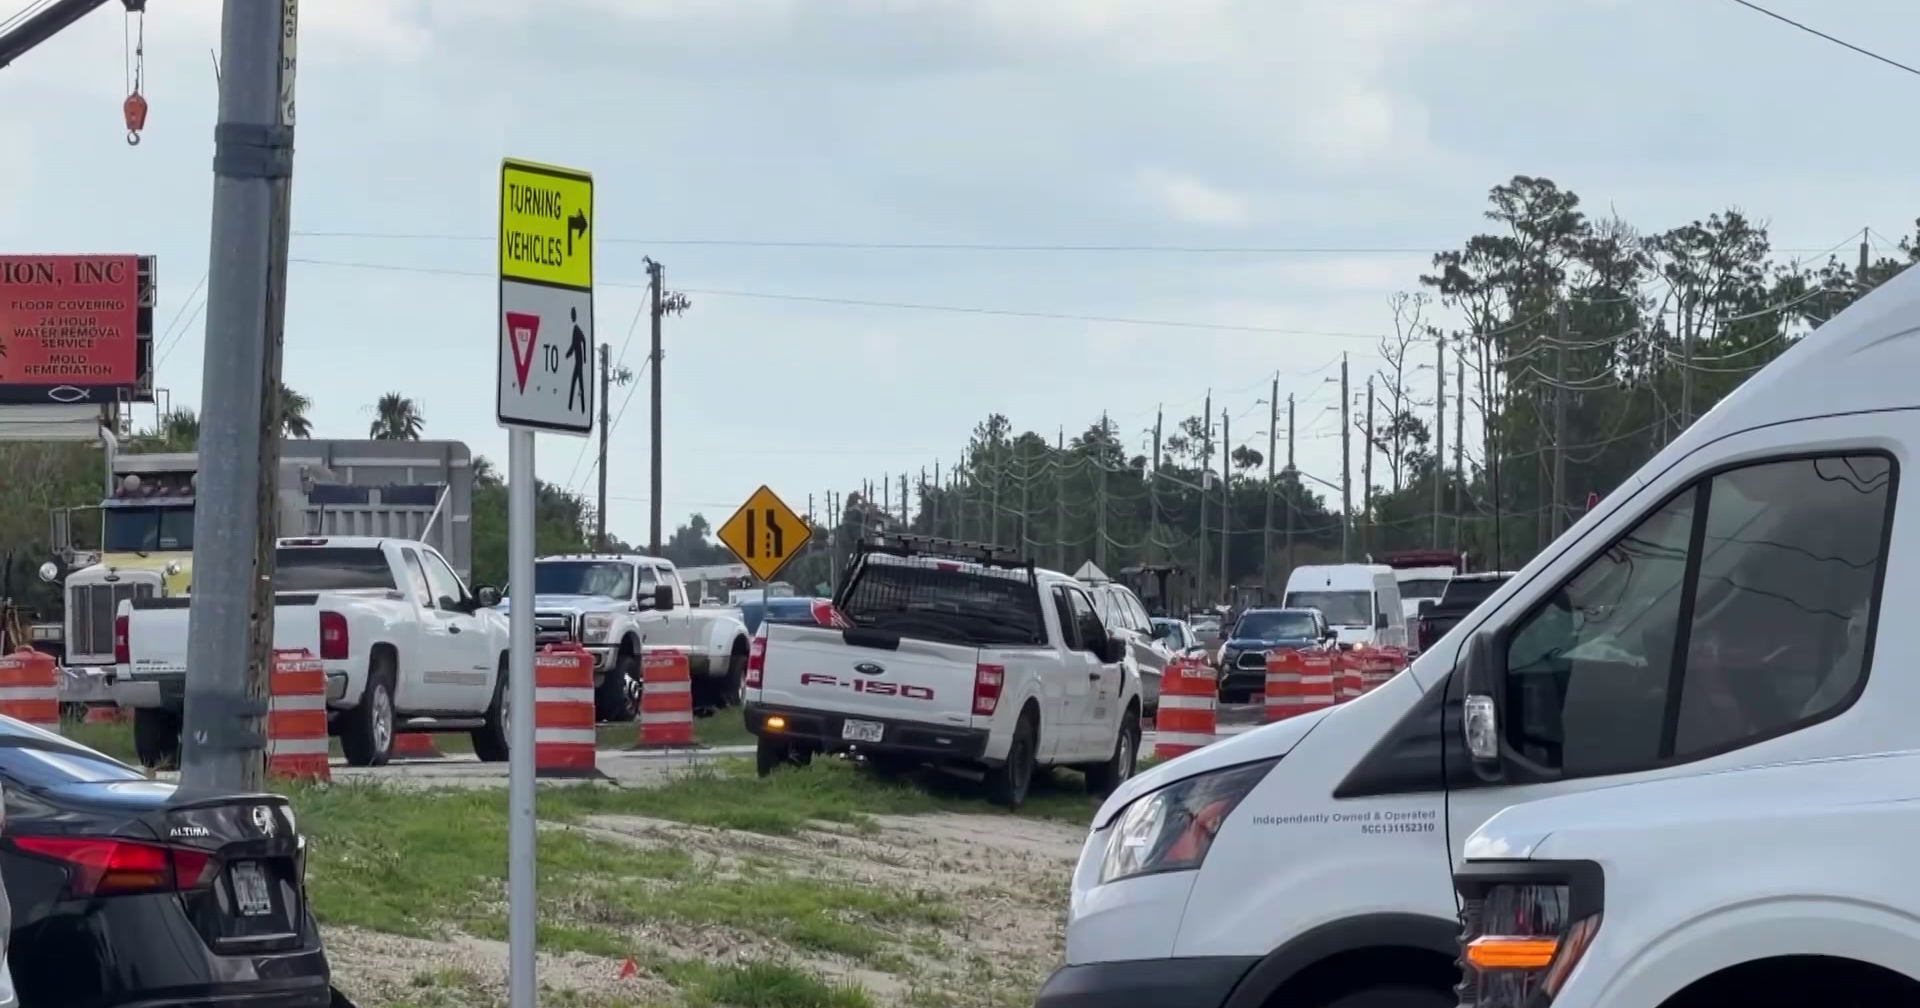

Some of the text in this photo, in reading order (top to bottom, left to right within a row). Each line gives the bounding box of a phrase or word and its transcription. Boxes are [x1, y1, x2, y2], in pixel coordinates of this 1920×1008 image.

[509, 183, 562, 220] TURNING
[506, 229, 563, 267] VEHICLES
[0, 261, 125, 288] ION, INC
[12, 301, 125, 311] FLOOR COVERING
[40, 317, 97, 326] 24 HOUR
[14, 328, 120, 338] WATER REMOVAL
[41, 339, 94, 348] SERVICE
[50, 355, 87, 364] MOLD
[543, 343, 559, 374] TO
[25, 365, 112, 375] REMEDIATION
[800, 673, 934, 700] F-150
[1253, 809, 1436, 825] Independently Owned & Operated
[170, 827, 210, 836] ALTIMA
